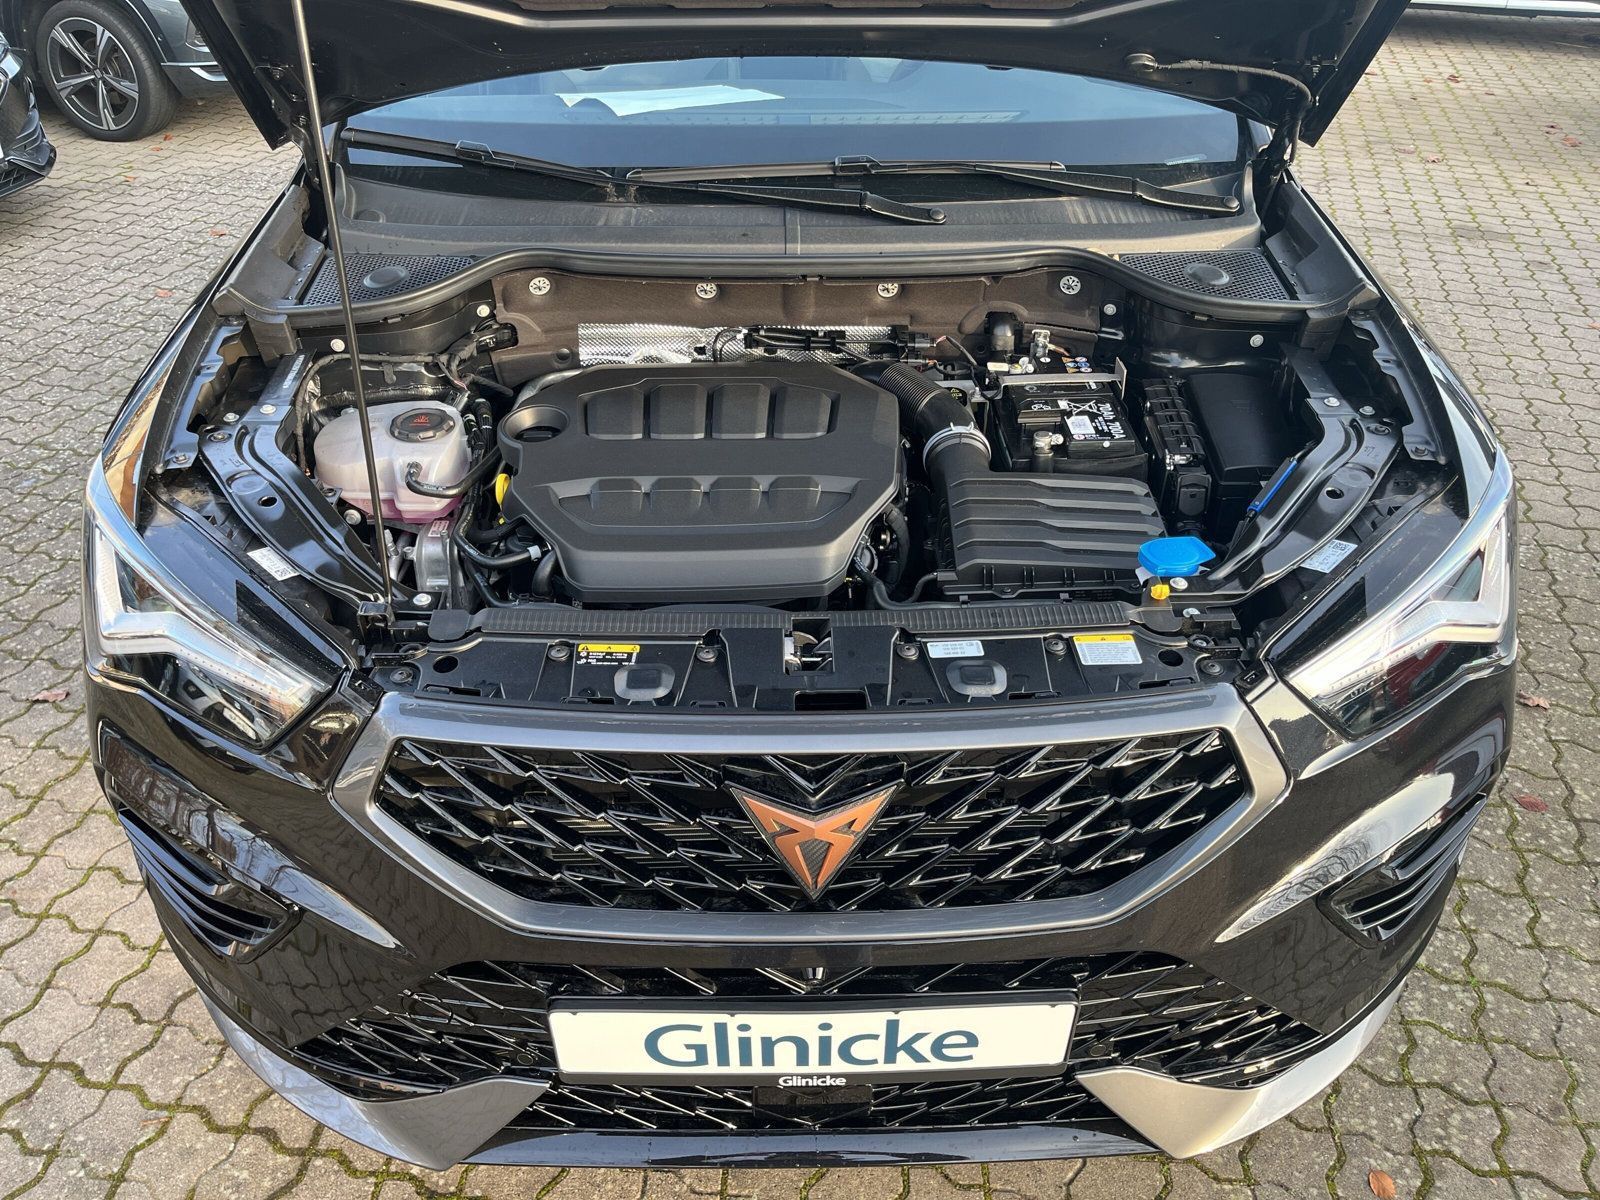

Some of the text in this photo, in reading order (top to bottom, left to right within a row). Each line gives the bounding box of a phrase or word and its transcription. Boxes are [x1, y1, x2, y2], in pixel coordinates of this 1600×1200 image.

[1098, 403, 1116, 420] 70Ah
[1107, 422, 1126, 439] 700A
[644, 1019, 980, 1067] Glinicke
[778, 1075, 847, 1087] Glinicke
